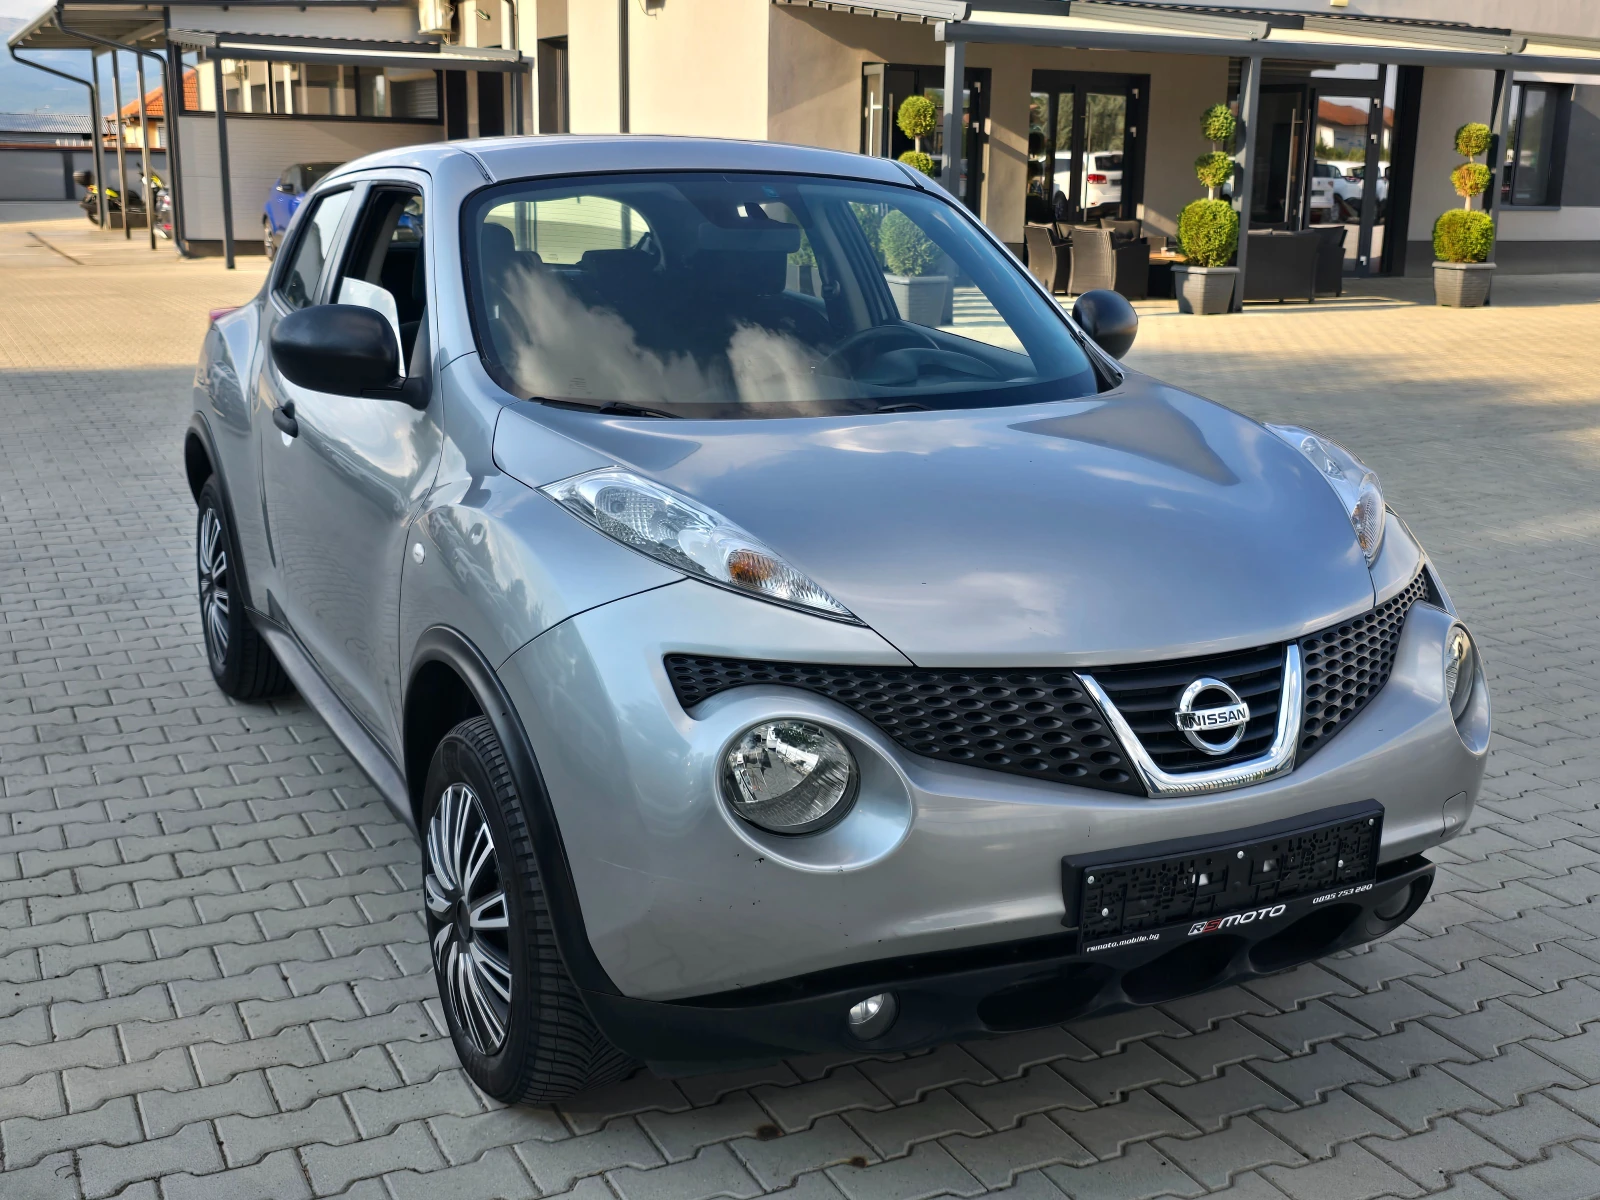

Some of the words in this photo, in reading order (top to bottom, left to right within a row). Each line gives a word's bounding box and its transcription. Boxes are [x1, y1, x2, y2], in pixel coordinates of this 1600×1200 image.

[1188, 707, 1246, 729] NISSAN
[1338, 888, 1355, 898] 753
[1188, 904, 1286, 936] RSMOTO
